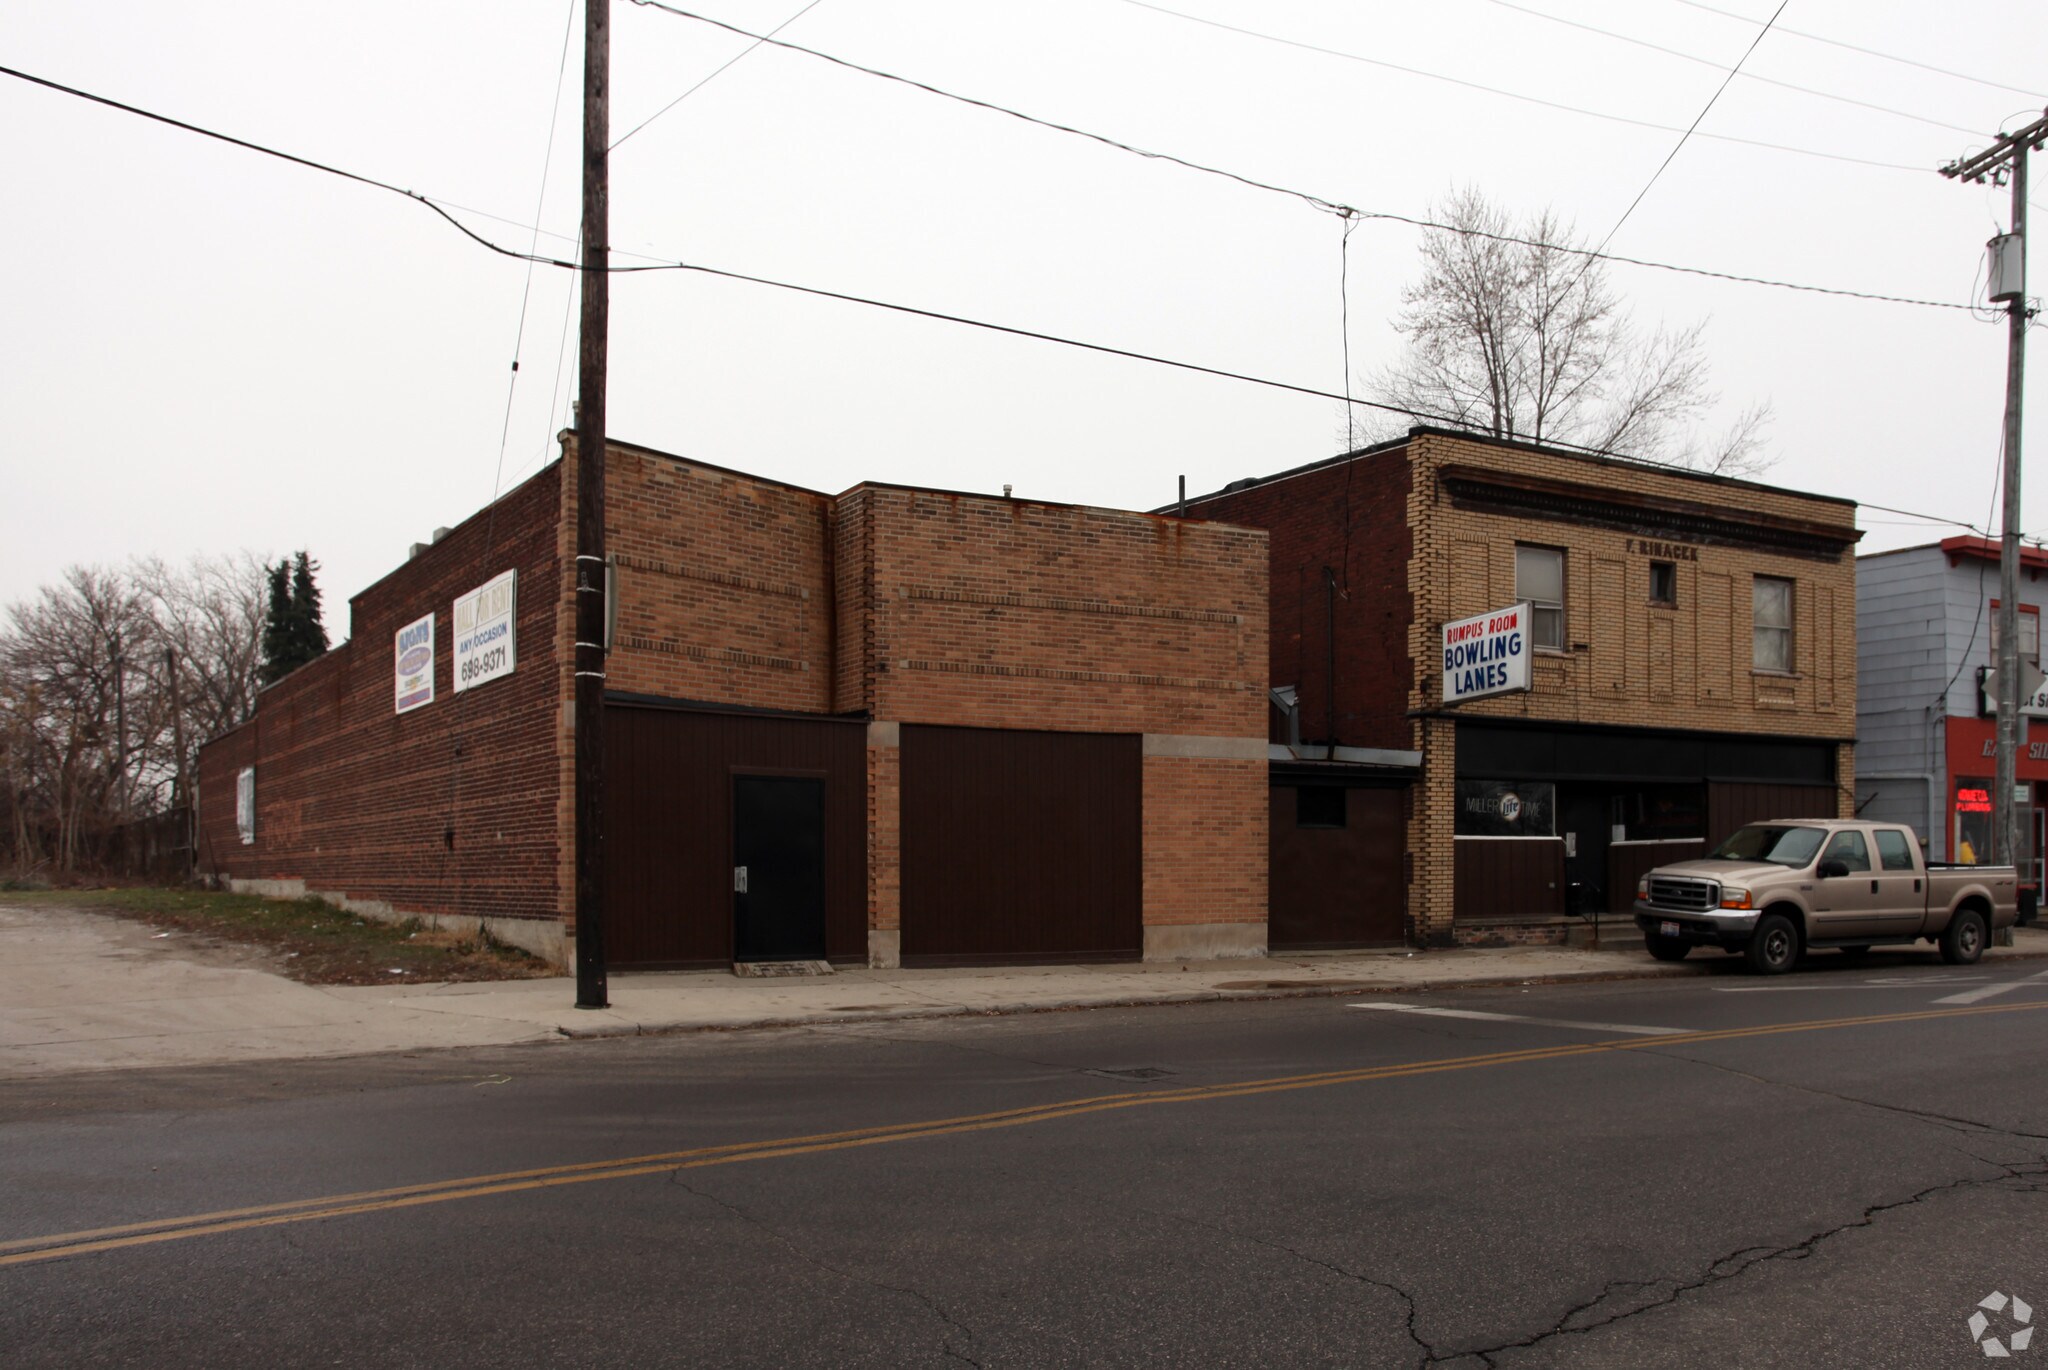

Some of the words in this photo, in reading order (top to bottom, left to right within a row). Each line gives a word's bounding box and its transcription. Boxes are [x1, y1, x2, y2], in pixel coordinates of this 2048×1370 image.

[460, 637, 473, 654] ANY
[474, 621, 507, 647] OCCASION
[1447, 621, 1483, 645] RUMPUS
[1489, 613, 1517, 634] ROOM
[461, 645, 506, 682] 698-9371
[1445, 633, 1521, 671] BOWLING
[1455, 662, 1507, 695] LANES
[1466, 797, 1499, 815] MILLER
[1521, 801, 1541, 817] TIME
